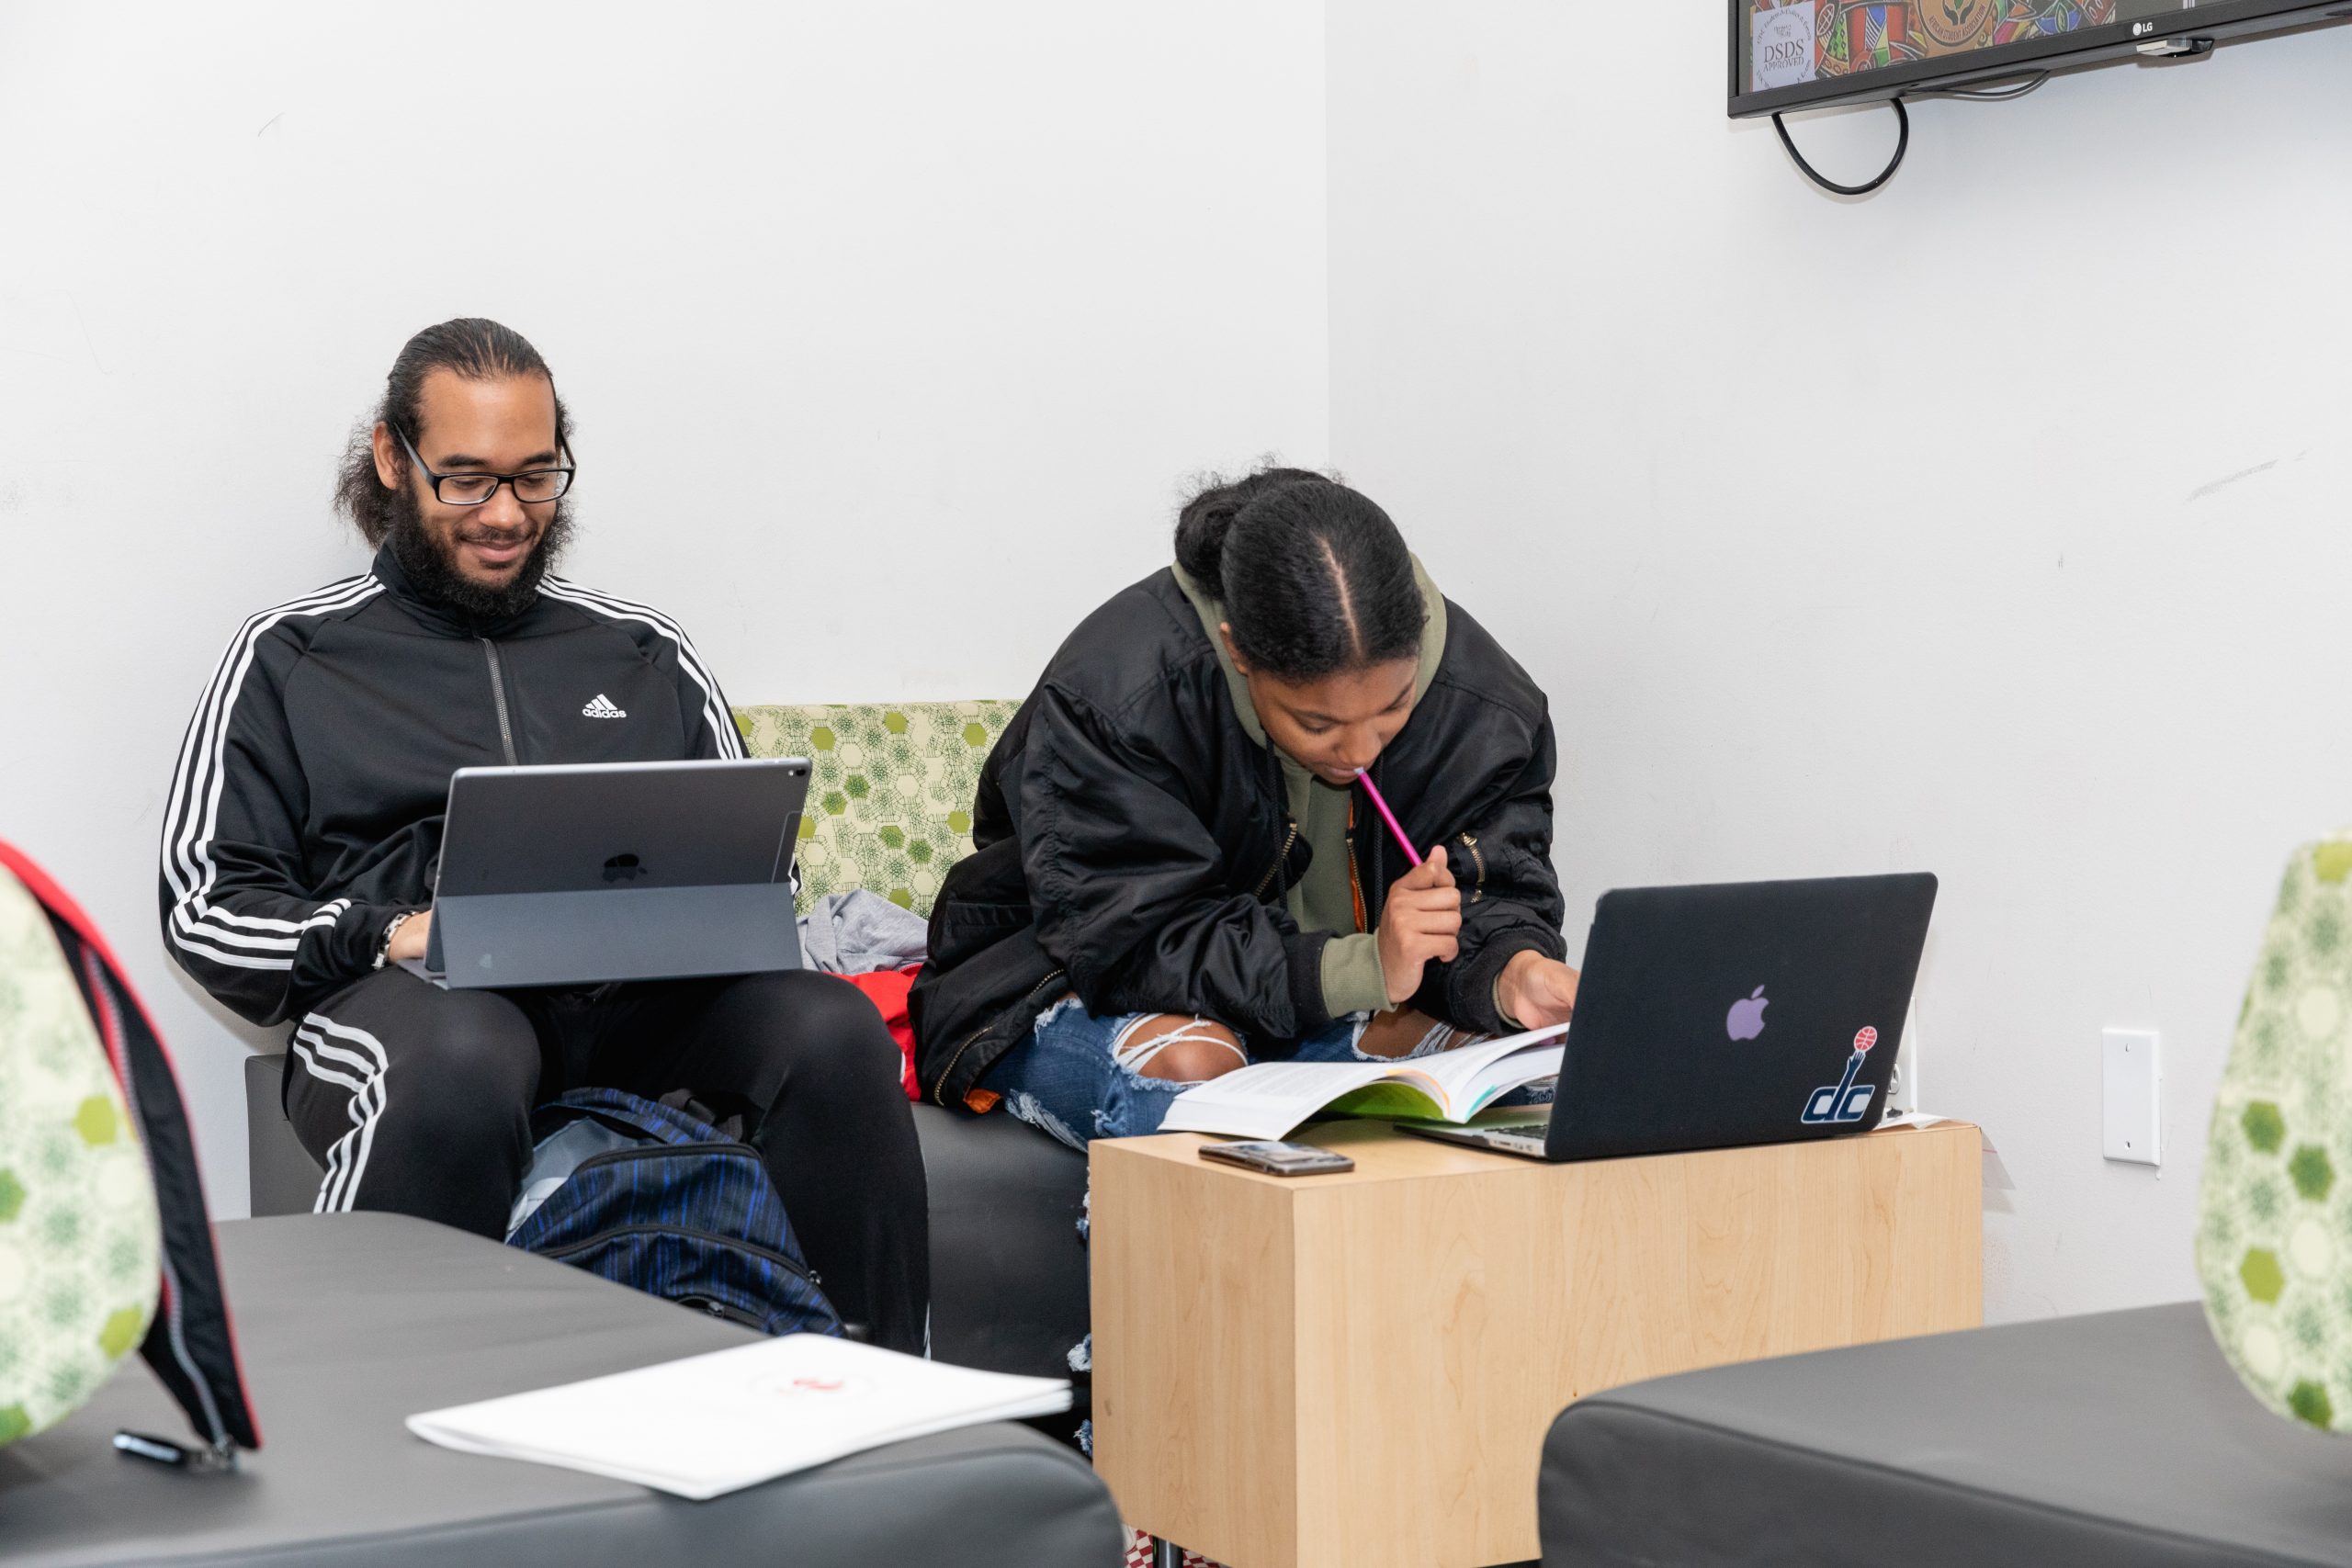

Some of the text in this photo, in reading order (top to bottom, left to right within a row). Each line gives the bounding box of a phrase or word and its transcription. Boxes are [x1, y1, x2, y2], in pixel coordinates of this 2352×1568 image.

[1942, 28, 1962, 40] STUDENT
[1962, 5, 1986, 37] ASSOCIATION
[2143, 22, 2153, 32] LG
[1764, 39, 1804, 62] DSDS
[1763, 57, 1804, 73] APPROVED
[582, 708, 627, 718] adidas
